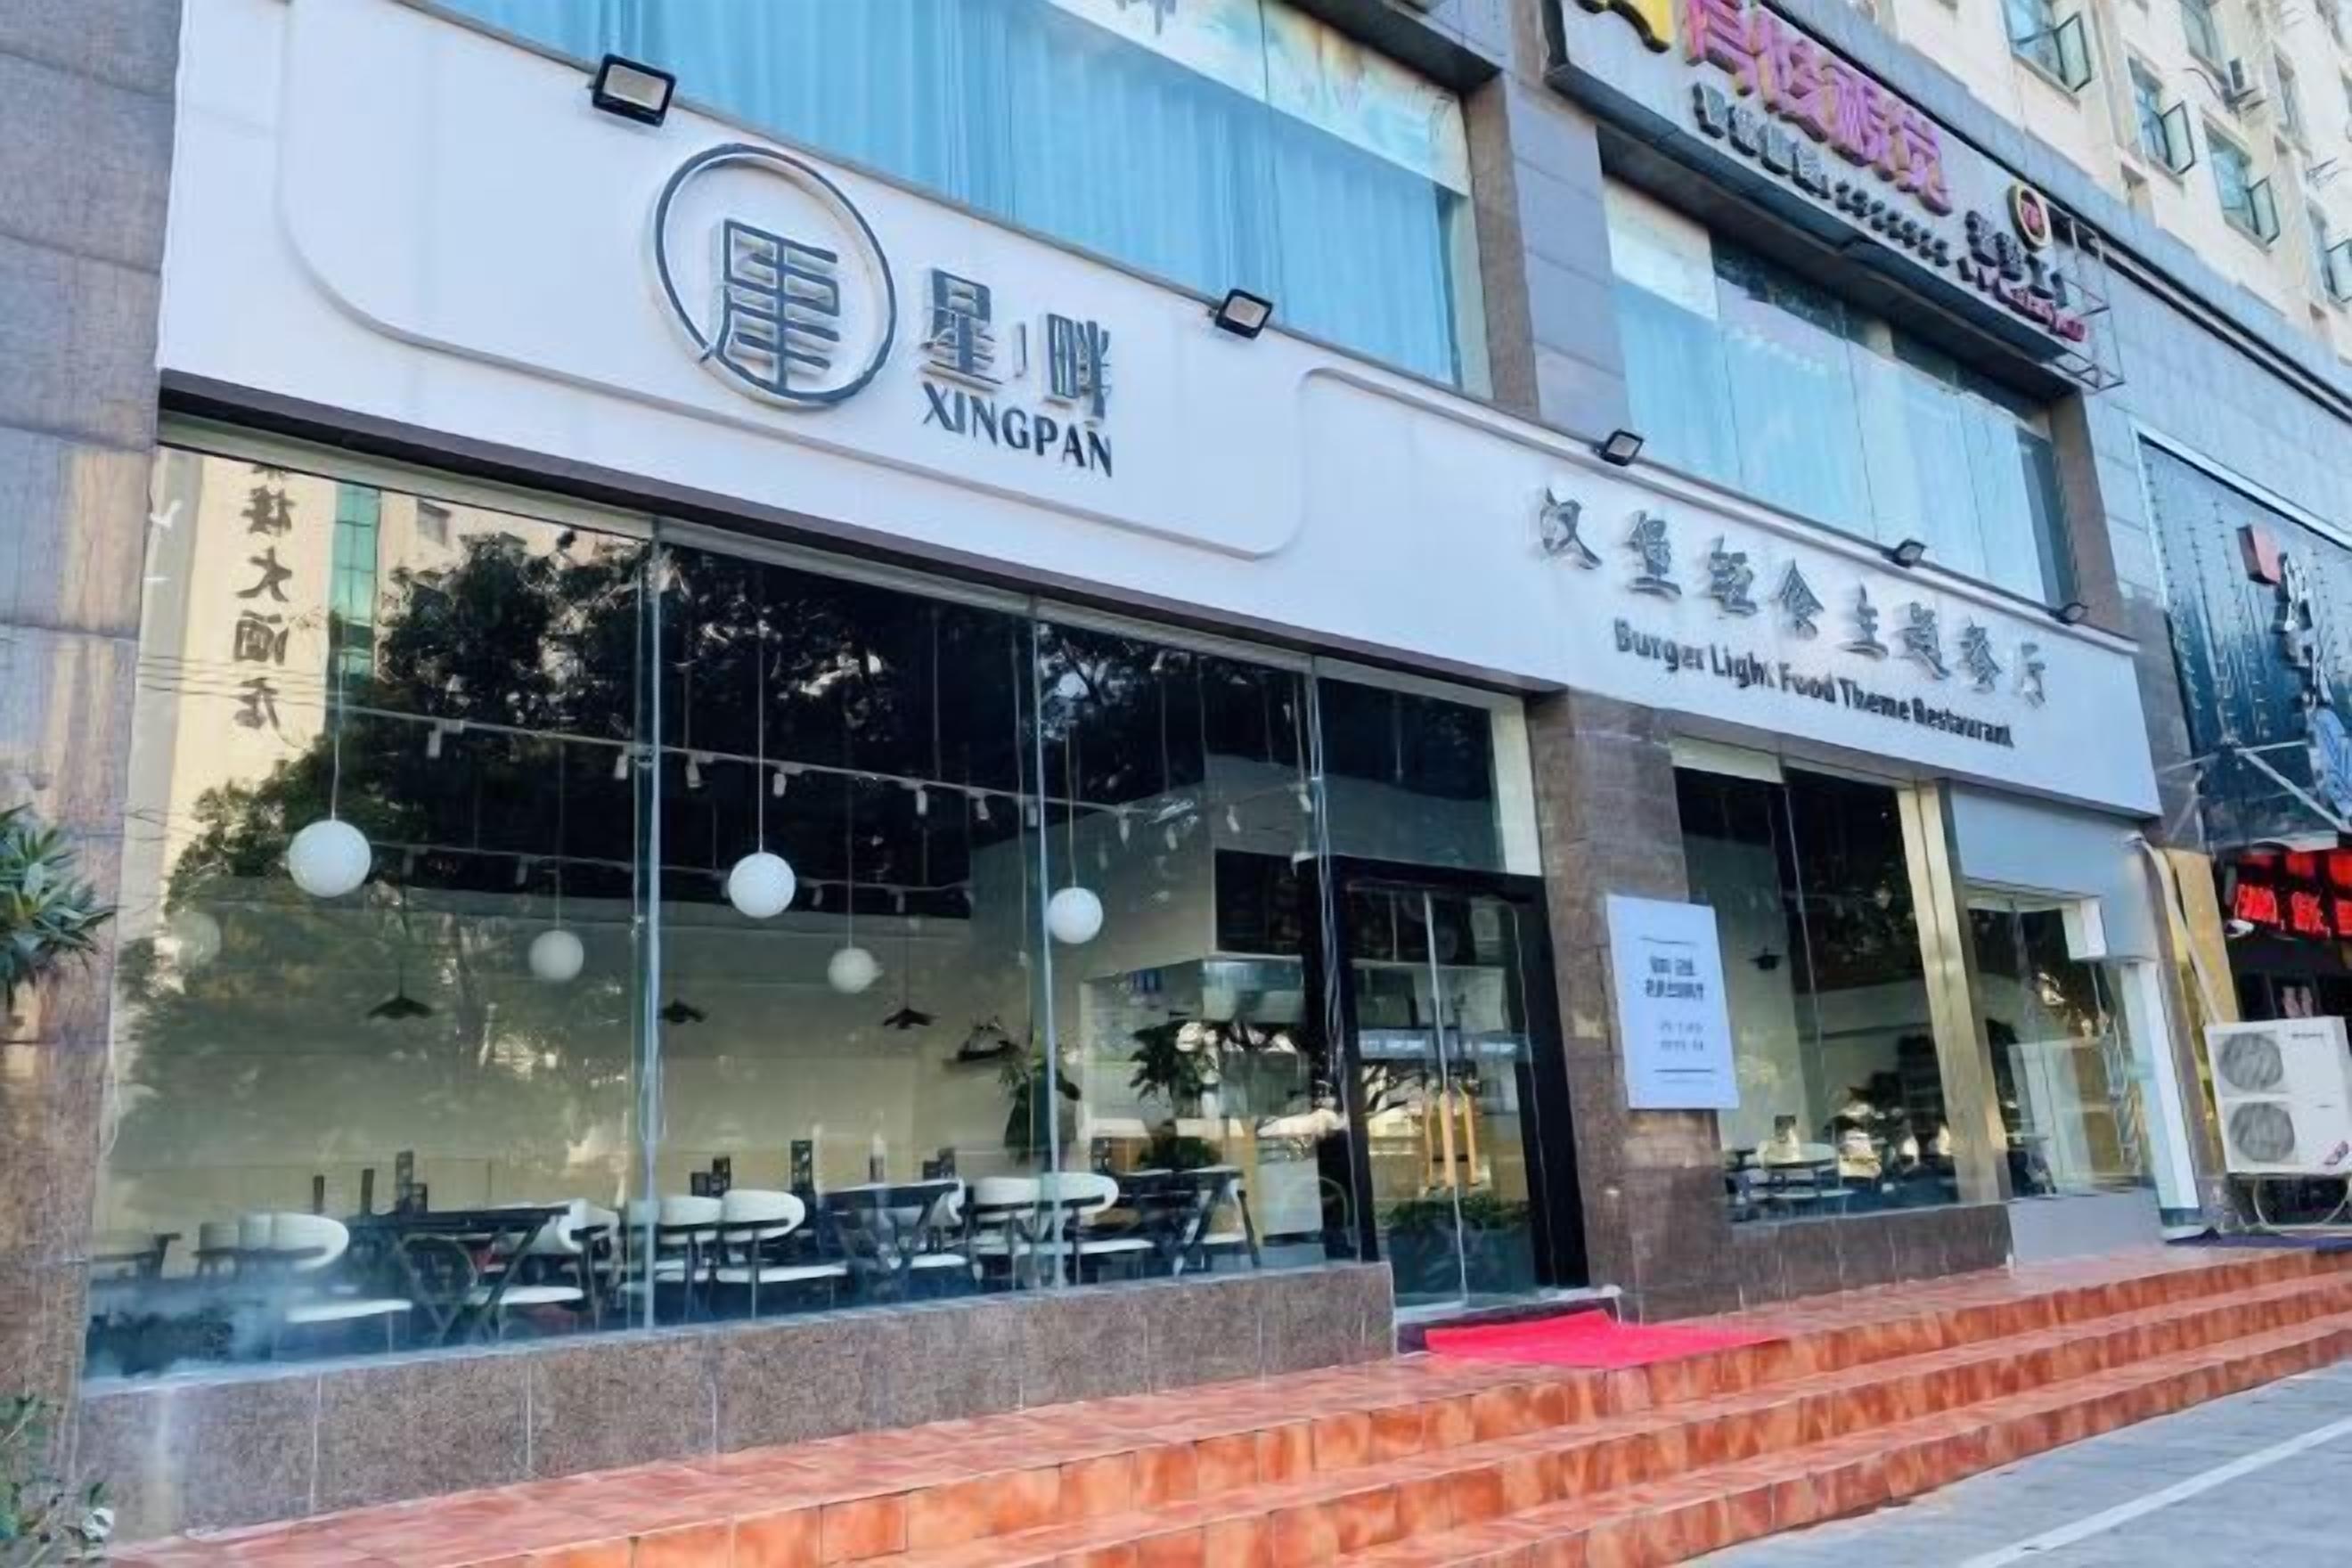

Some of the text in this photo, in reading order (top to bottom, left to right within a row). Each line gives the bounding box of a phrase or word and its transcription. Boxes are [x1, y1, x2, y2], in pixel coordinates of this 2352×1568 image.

[922, 380, 1112, 478] XINGPAN
[1614, 617, 2015, 748] Burger Light Food Theme Restaurant
